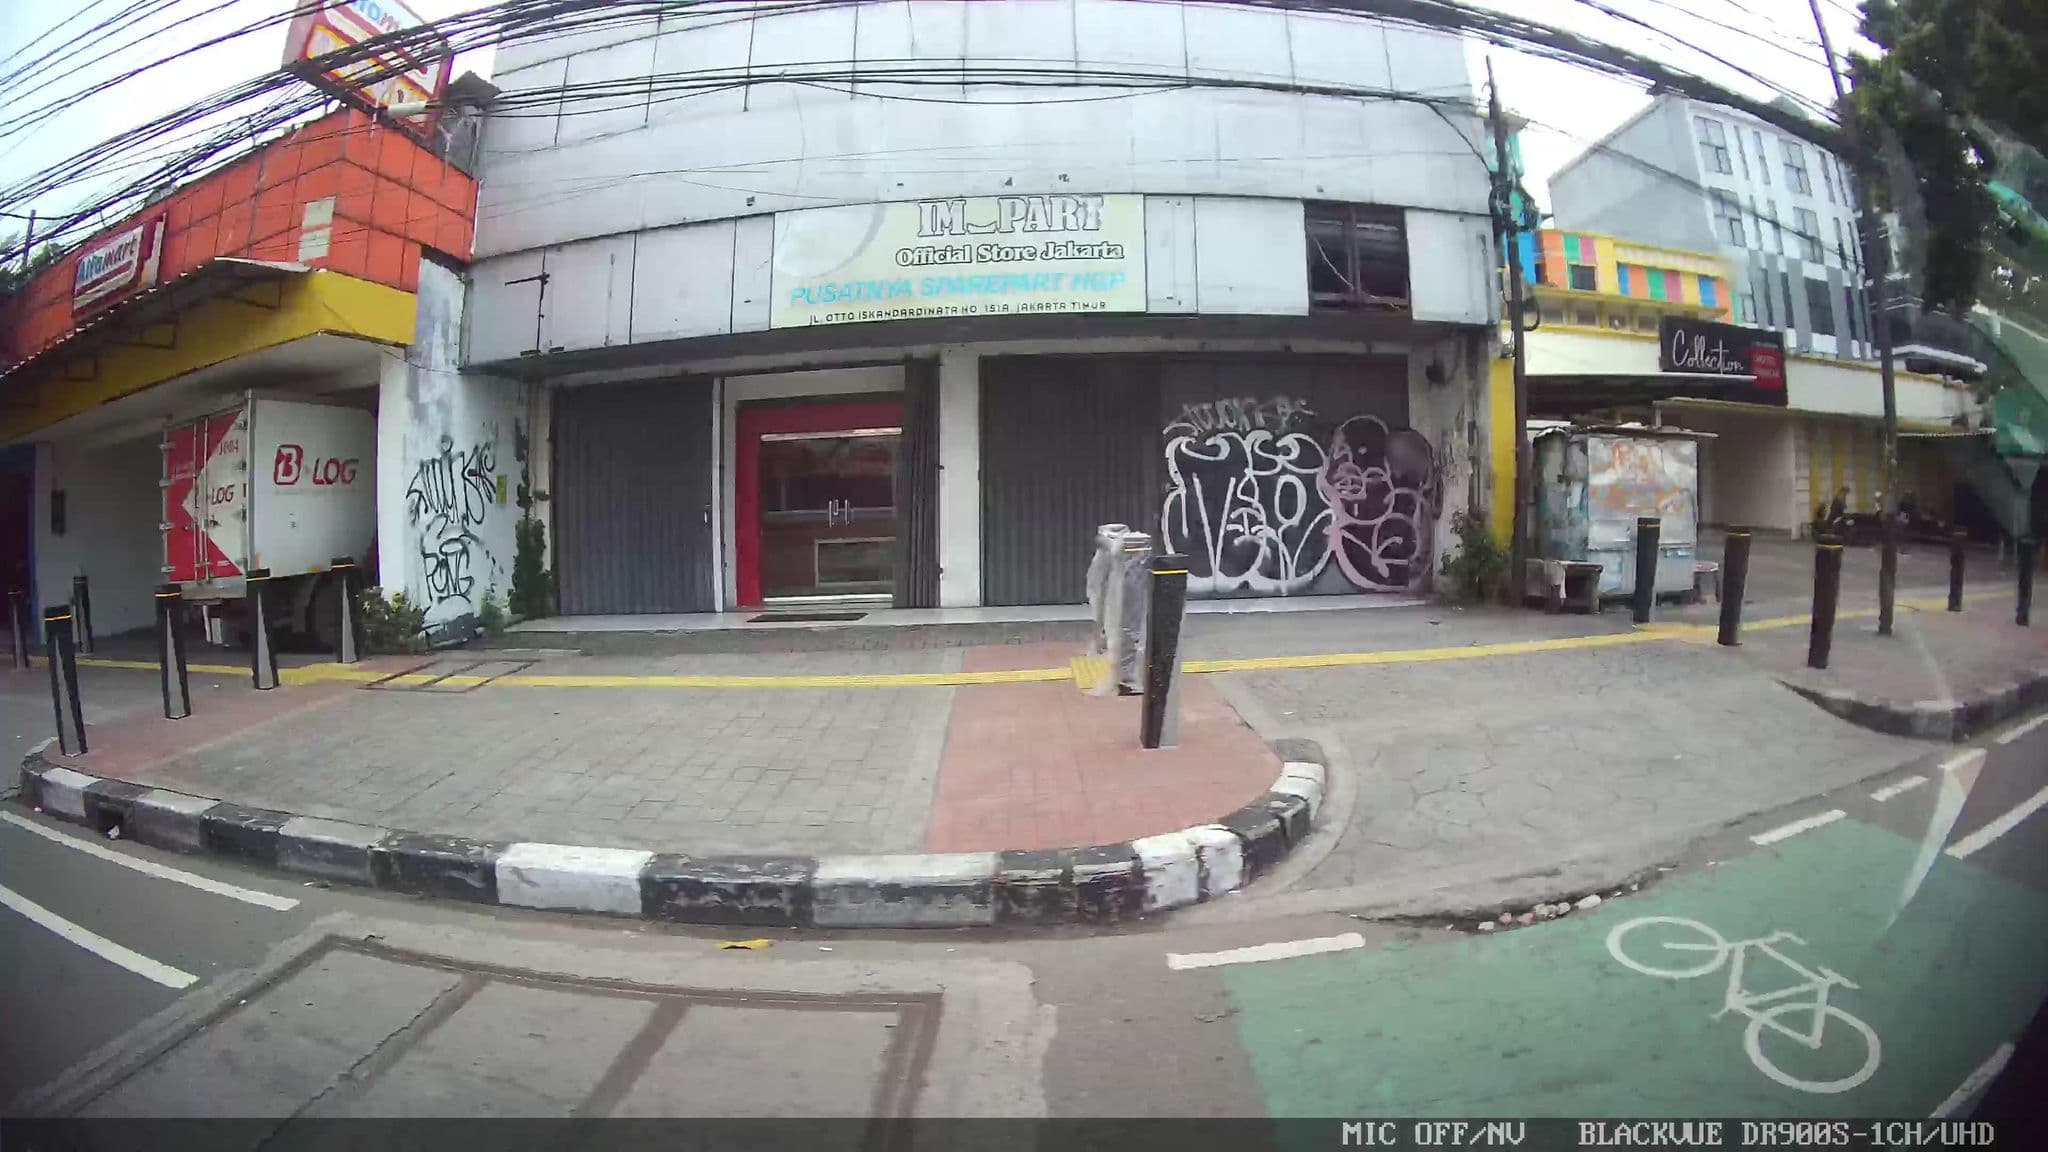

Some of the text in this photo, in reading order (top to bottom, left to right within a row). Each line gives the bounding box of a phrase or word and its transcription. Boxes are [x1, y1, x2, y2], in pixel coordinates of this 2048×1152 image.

[895, 240, 1125, 267] Official Store Jakarta
[790, 277, 913, 307] PUSATNYA
[826, 312, 855, 322] OTTO
[858, 305, 957, 320] ISKANDARDINATA
[1016, 301, 1066, 313] JAKARTA
[1071, 301, 1107, 311] TIMUR
[1672, 329, 1744, 375] Collection
[211, 484, 235, 505] LOG
